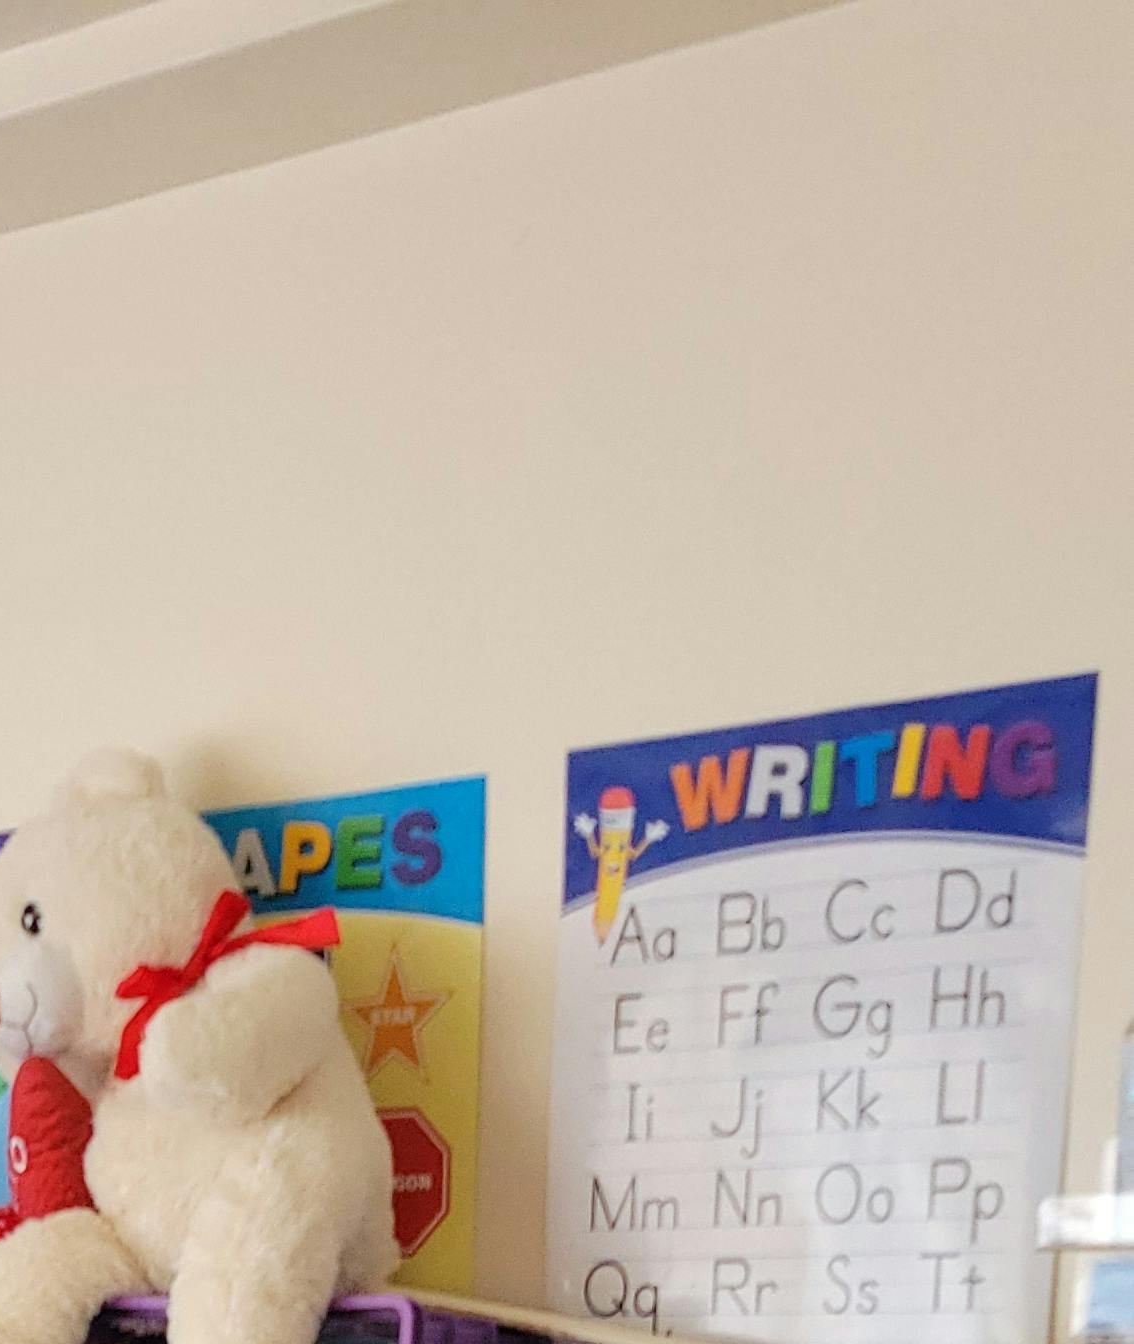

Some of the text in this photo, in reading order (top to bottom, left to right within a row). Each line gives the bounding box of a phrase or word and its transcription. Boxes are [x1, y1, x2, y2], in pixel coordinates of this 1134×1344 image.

[670, 720, 1056, 832] WRITING
[234, 809, 444, 898] APES
[610, 868, 1019, 967] Aa Bb Cc Dd
[613, 964, 1007, 1060] Ee Ff Gg Hh
[624, 1059, 987, 1160] Ii Jj Kk Ll
[589, 1158, 1004, 1245] Mm Nn Oo Pp
[583, 1252, 987, 1338] Qq Rr Ss Tt
